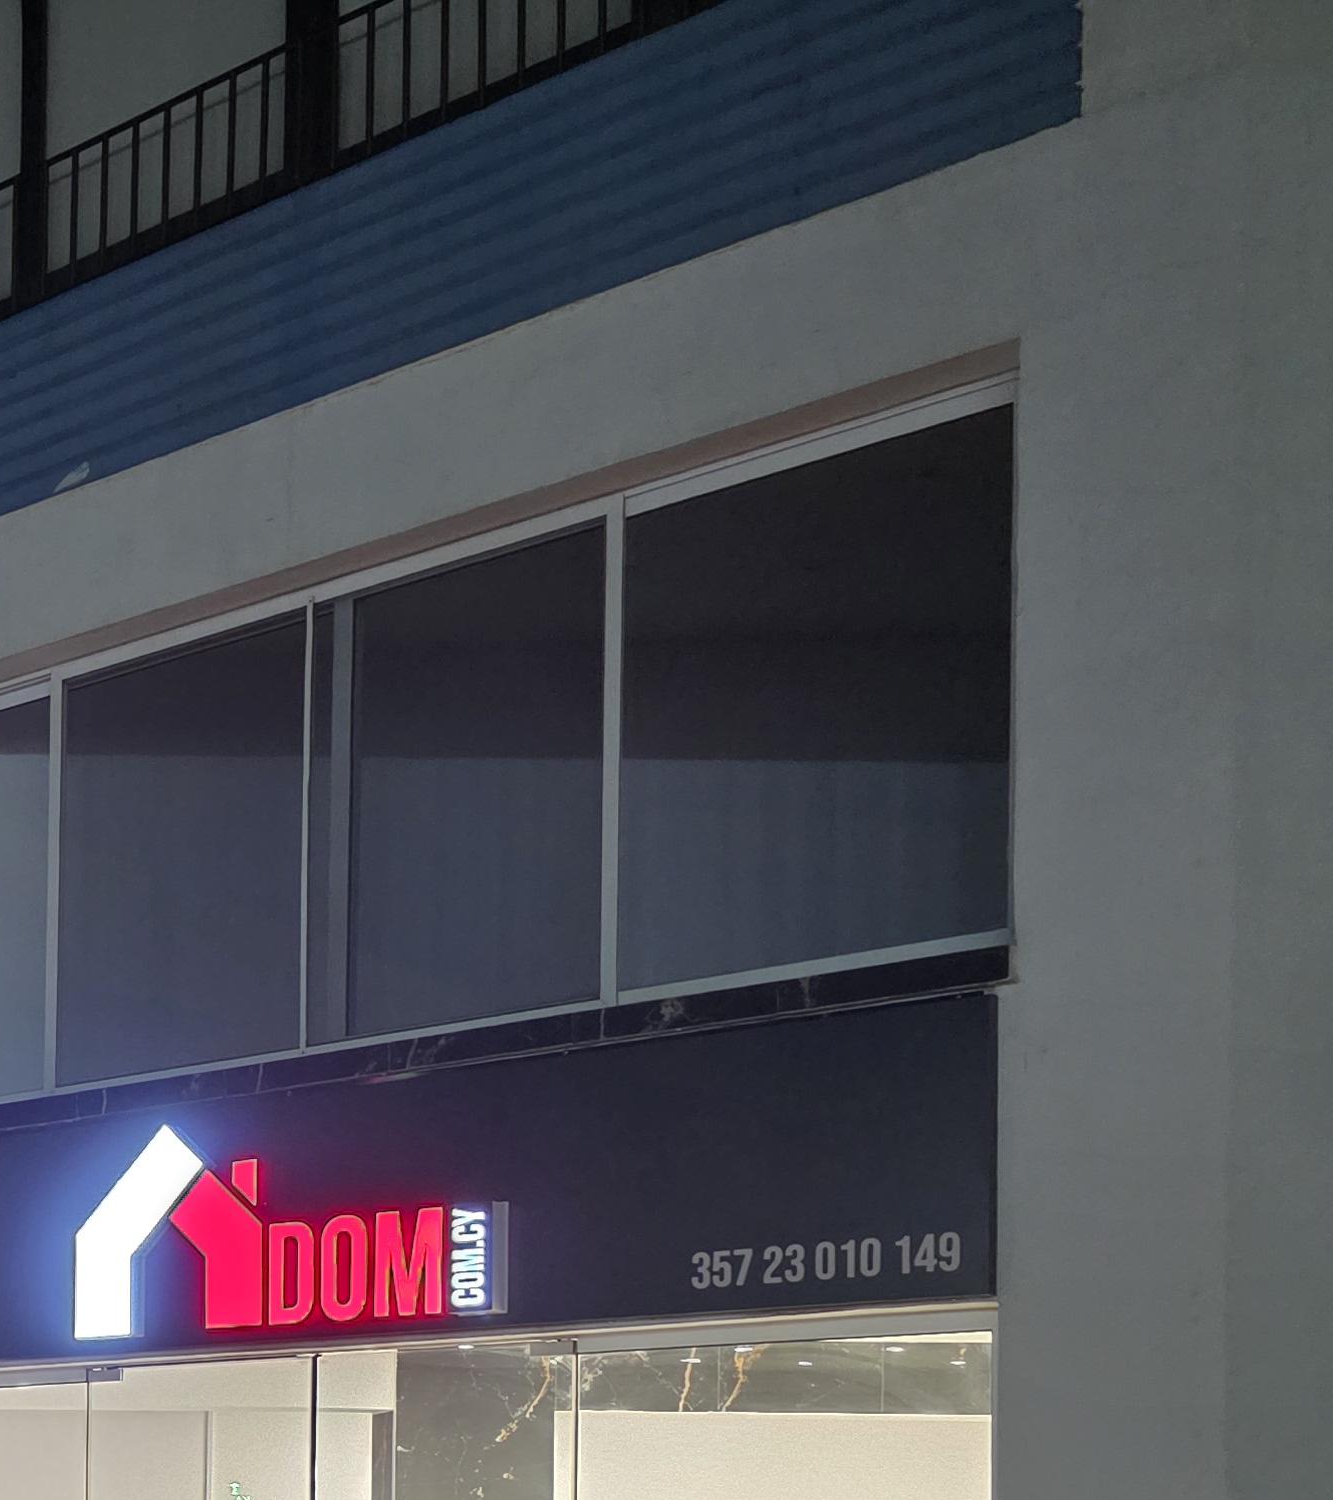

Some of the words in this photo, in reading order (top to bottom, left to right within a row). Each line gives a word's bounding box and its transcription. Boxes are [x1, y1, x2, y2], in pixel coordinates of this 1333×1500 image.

[450, 1208, 486, 1308] COM.CY
[691, 1248, 753, 1289] 357
[762, 1244, 805, 1283] 23
[815, 1237, 881, 1280] 010
[895, 1231, 961, 1274] 149
